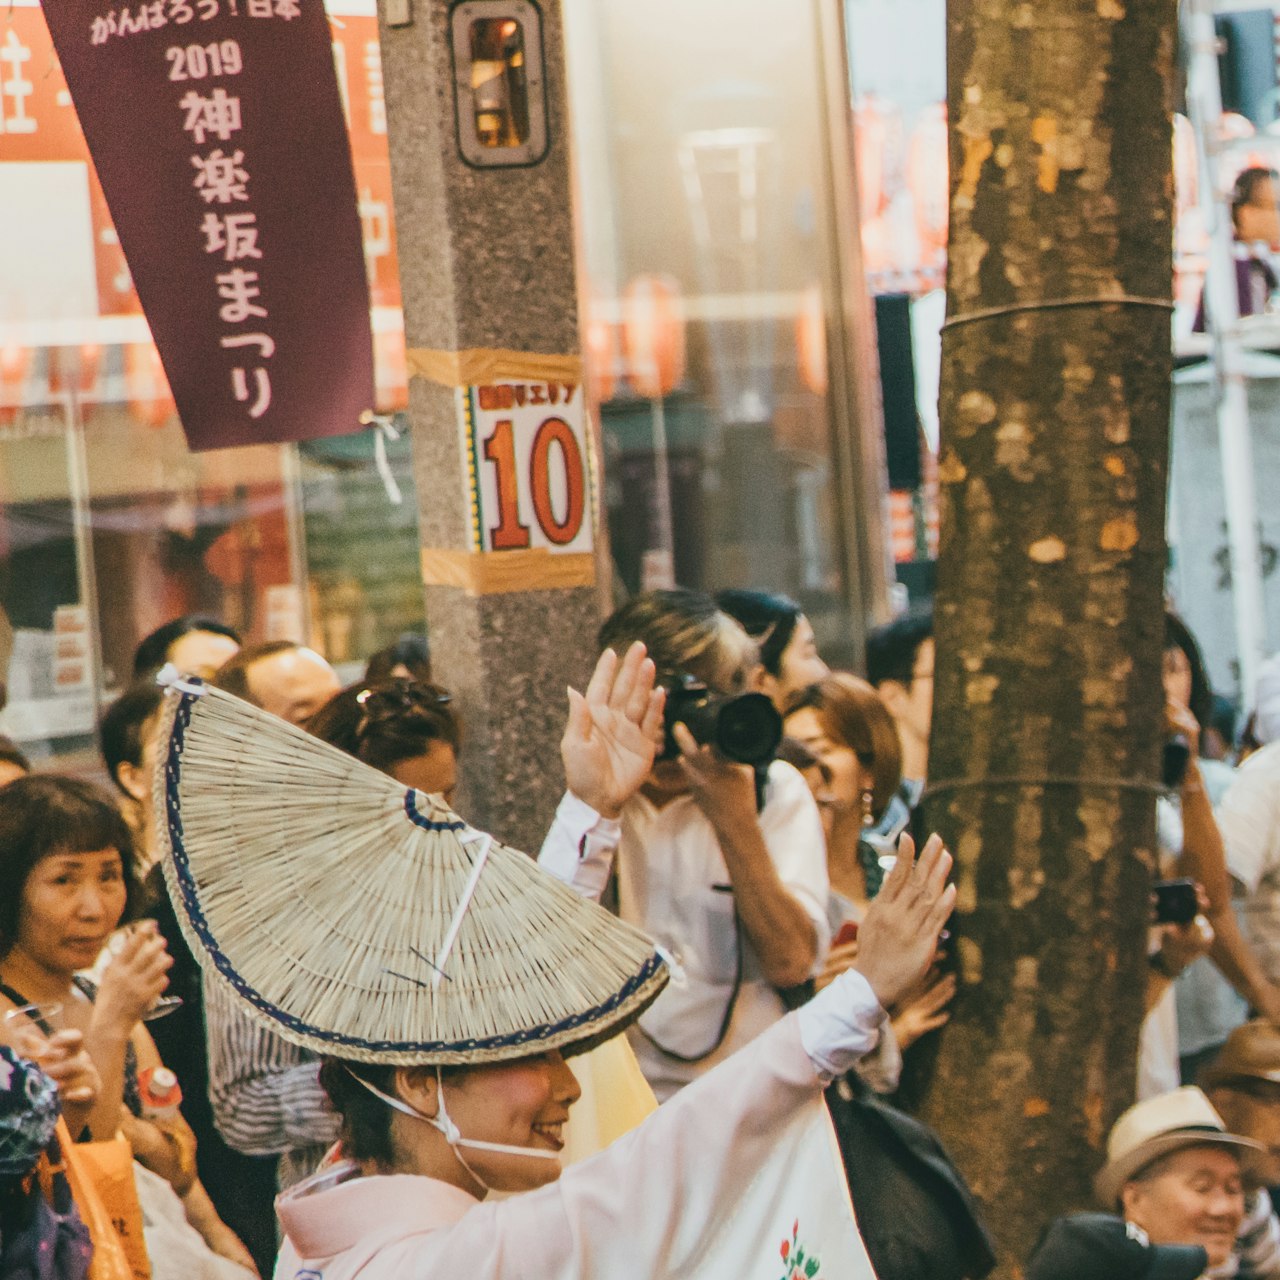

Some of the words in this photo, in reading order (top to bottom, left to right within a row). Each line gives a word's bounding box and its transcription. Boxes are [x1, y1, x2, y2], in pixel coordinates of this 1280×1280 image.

[165, 39, 243, 82] 2019
[179, 87, 276, 418] 神楽坂まつり
[484, 416, 586, 550] 10
